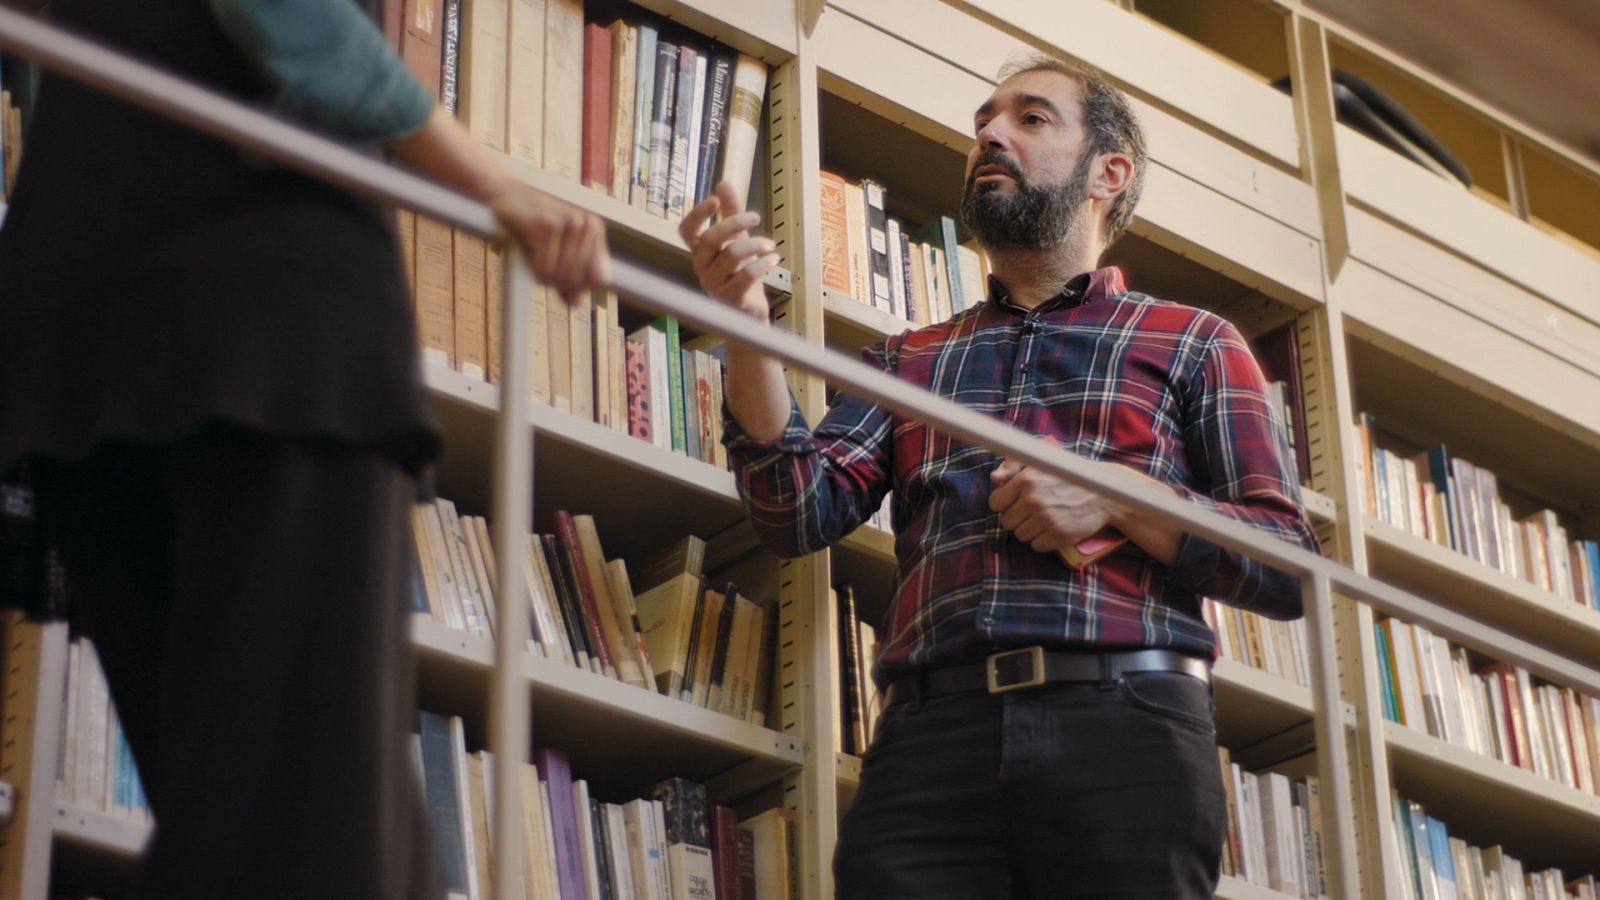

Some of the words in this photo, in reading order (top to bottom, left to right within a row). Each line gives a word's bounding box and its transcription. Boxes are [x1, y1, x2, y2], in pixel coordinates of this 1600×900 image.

[715, 60, 728, 83] Man
[712, 82, 724, 105] and
[708, 118, 721, 144] Gods
